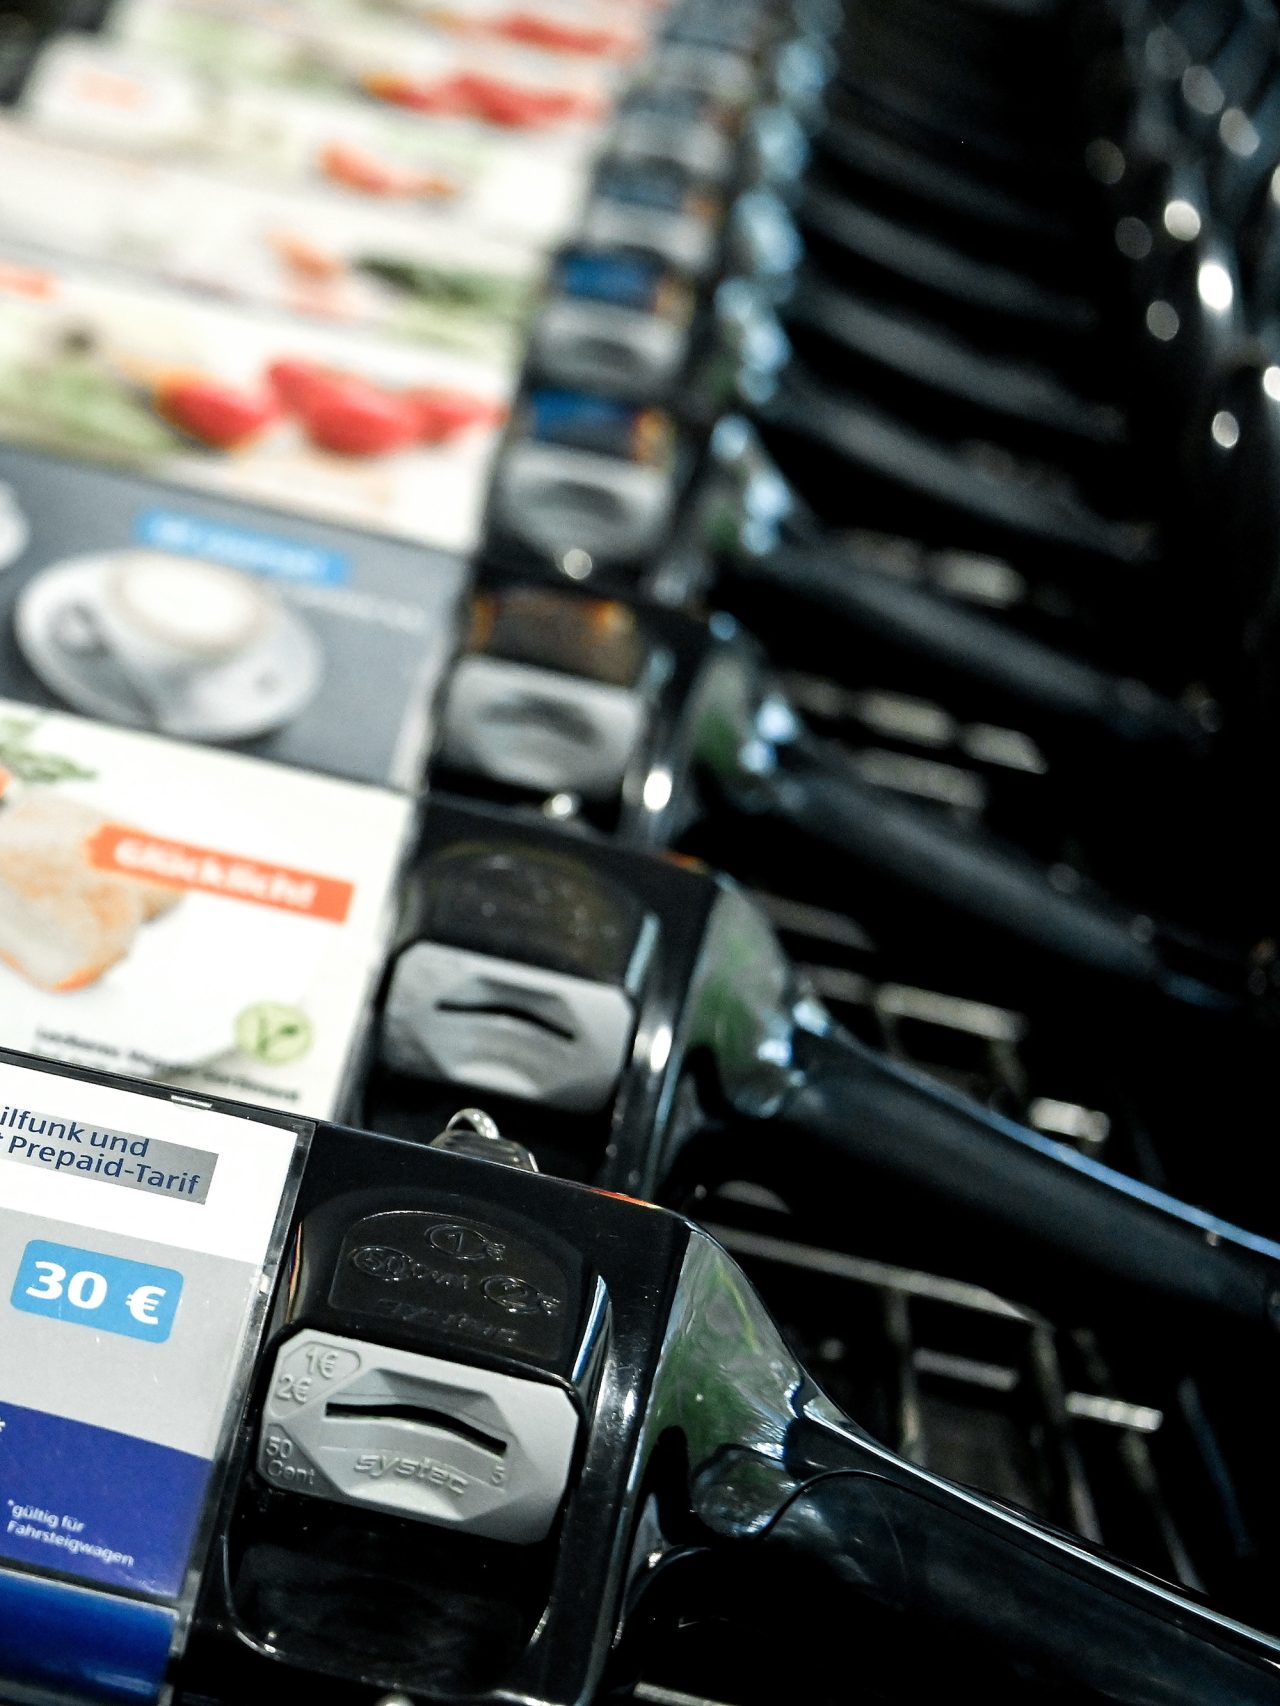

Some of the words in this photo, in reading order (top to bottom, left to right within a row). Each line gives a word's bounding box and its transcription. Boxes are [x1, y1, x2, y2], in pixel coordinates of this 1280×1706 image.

[91, 1131, 150, 1158] und
[7, 1135, 201, 1195] Prepaid-Tarif
[25, 1260, 109, 1310] 30
[125, 1284, 167, 1326] €
[266, 1436, 293, 1460] 50
[61, 1515, 86, 1533] für
[6, 1519, 135, 1568] Fahrsteigwagen
